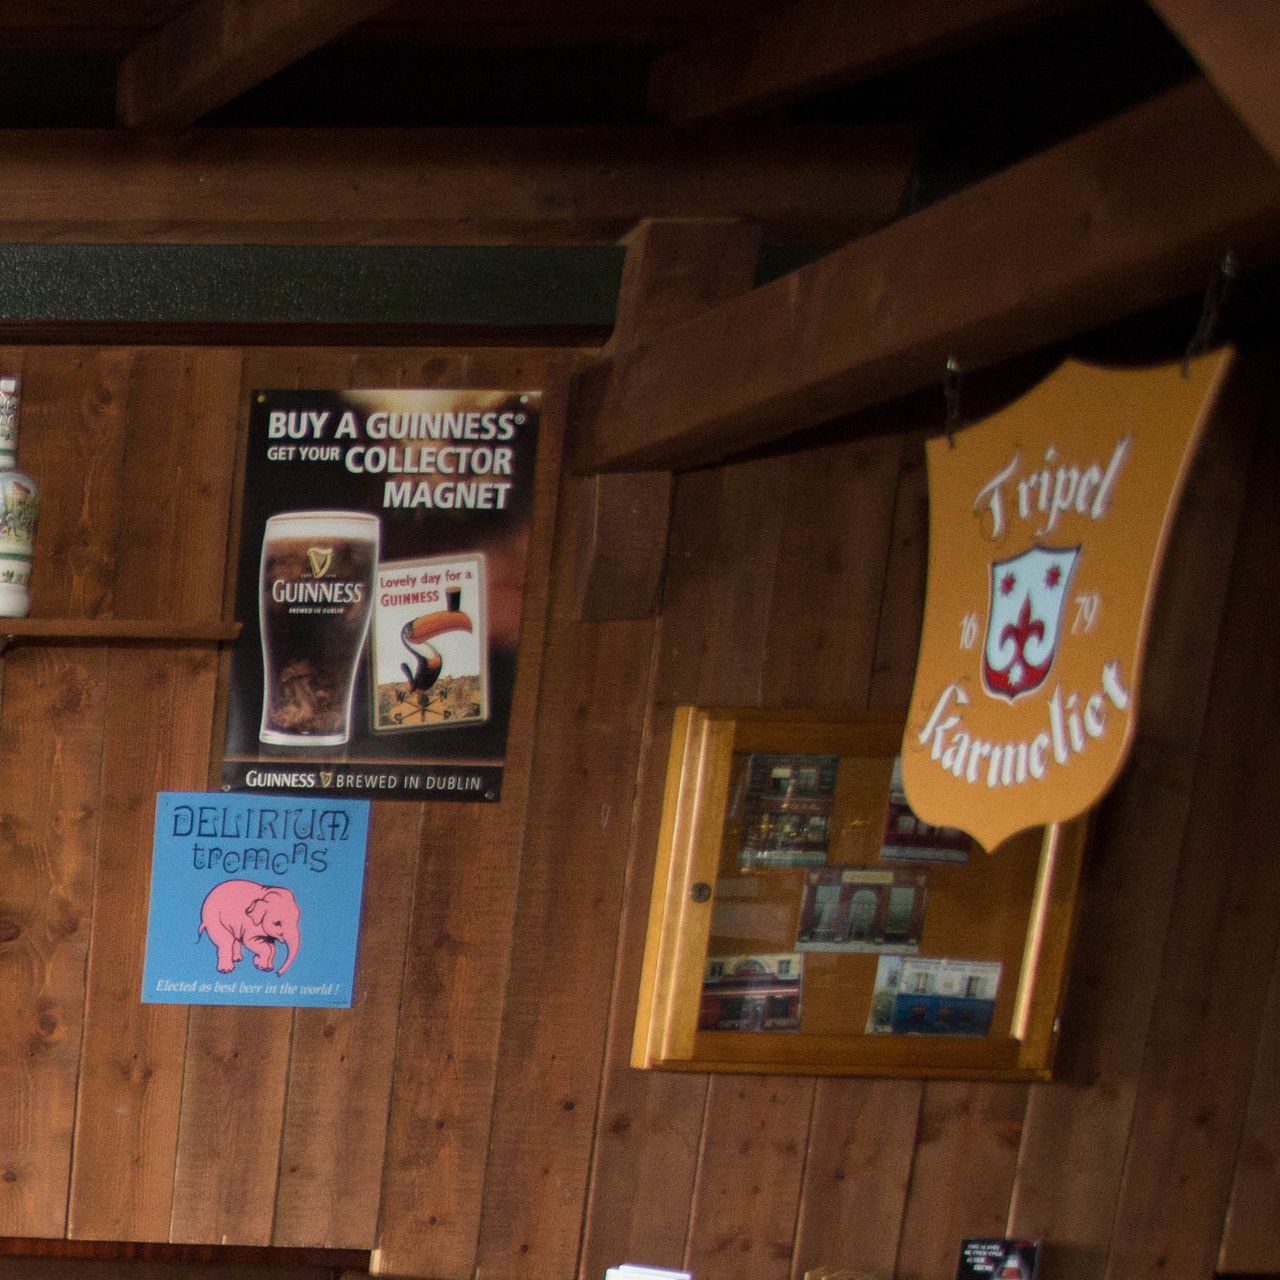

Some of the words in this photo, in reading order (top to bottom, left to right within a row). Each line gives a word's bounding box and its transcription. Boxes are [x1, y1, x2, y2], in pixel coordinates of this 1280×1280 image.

[267, 410, 329, 440] BUY
[334, 410, 359, 440] A
[267, 446, 296, 462] GET
[298, 446, 341, 462] YOUR
[345, 446, 513, 476] COLLECTOR
[382, 482, 511, 511] MAGNET
[973, 434, 1133, 538] Tripel
[272, 580, 363, 603] GUINNESS
[379, 575, 417, 590] Lovely
[420, 572, 441, 588] day
[444, 569, 462, 582] for
[464, 571, 473, 580] a
[380, 590, 440, 608] GUINNESS
[917, 659, 1129, 789] Karmeliet
[245, 769, 315, 788] GUINNESS
[336, 773, 397, 789] BREWED
[403, 774, 419, 789] IN
[425, 775, 482, 791] DUBLIN
[171, 804, 351, 842] DELIRIUM
[191, 841, 329, 875] tremens
[156, 979, 196, 993] Elected
[198, 984, 212, 993] as
[215, 981, 236, 993] best
[239, 982, 261, 994] beer
[265, 982, 278, 994] in
[279, 982, 297, 994] the
